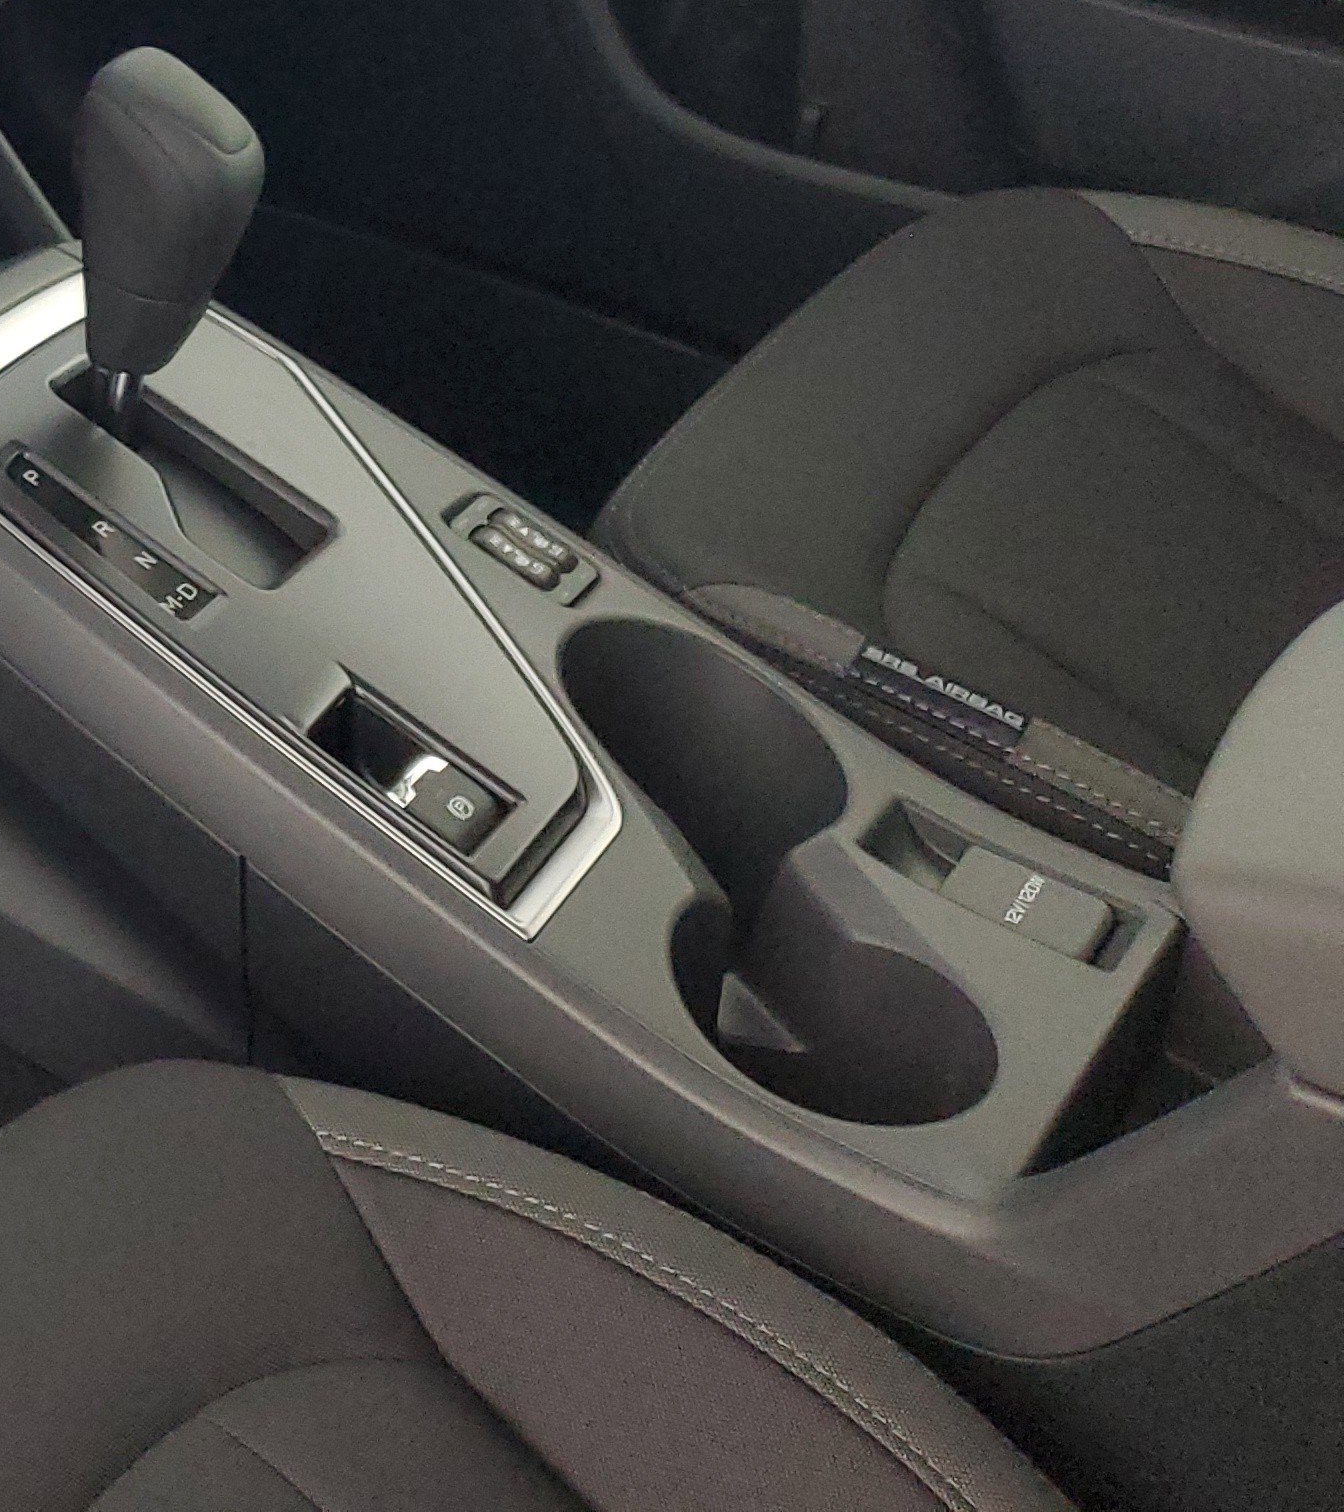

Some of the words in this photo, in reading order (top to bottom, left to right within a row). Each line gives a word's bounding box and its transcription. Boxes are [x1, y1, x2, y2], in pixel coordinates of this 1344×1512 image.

[22, 469, 40, 487] P
[91, 520, 116, 538] R
[133, 551, 159, 570] N
